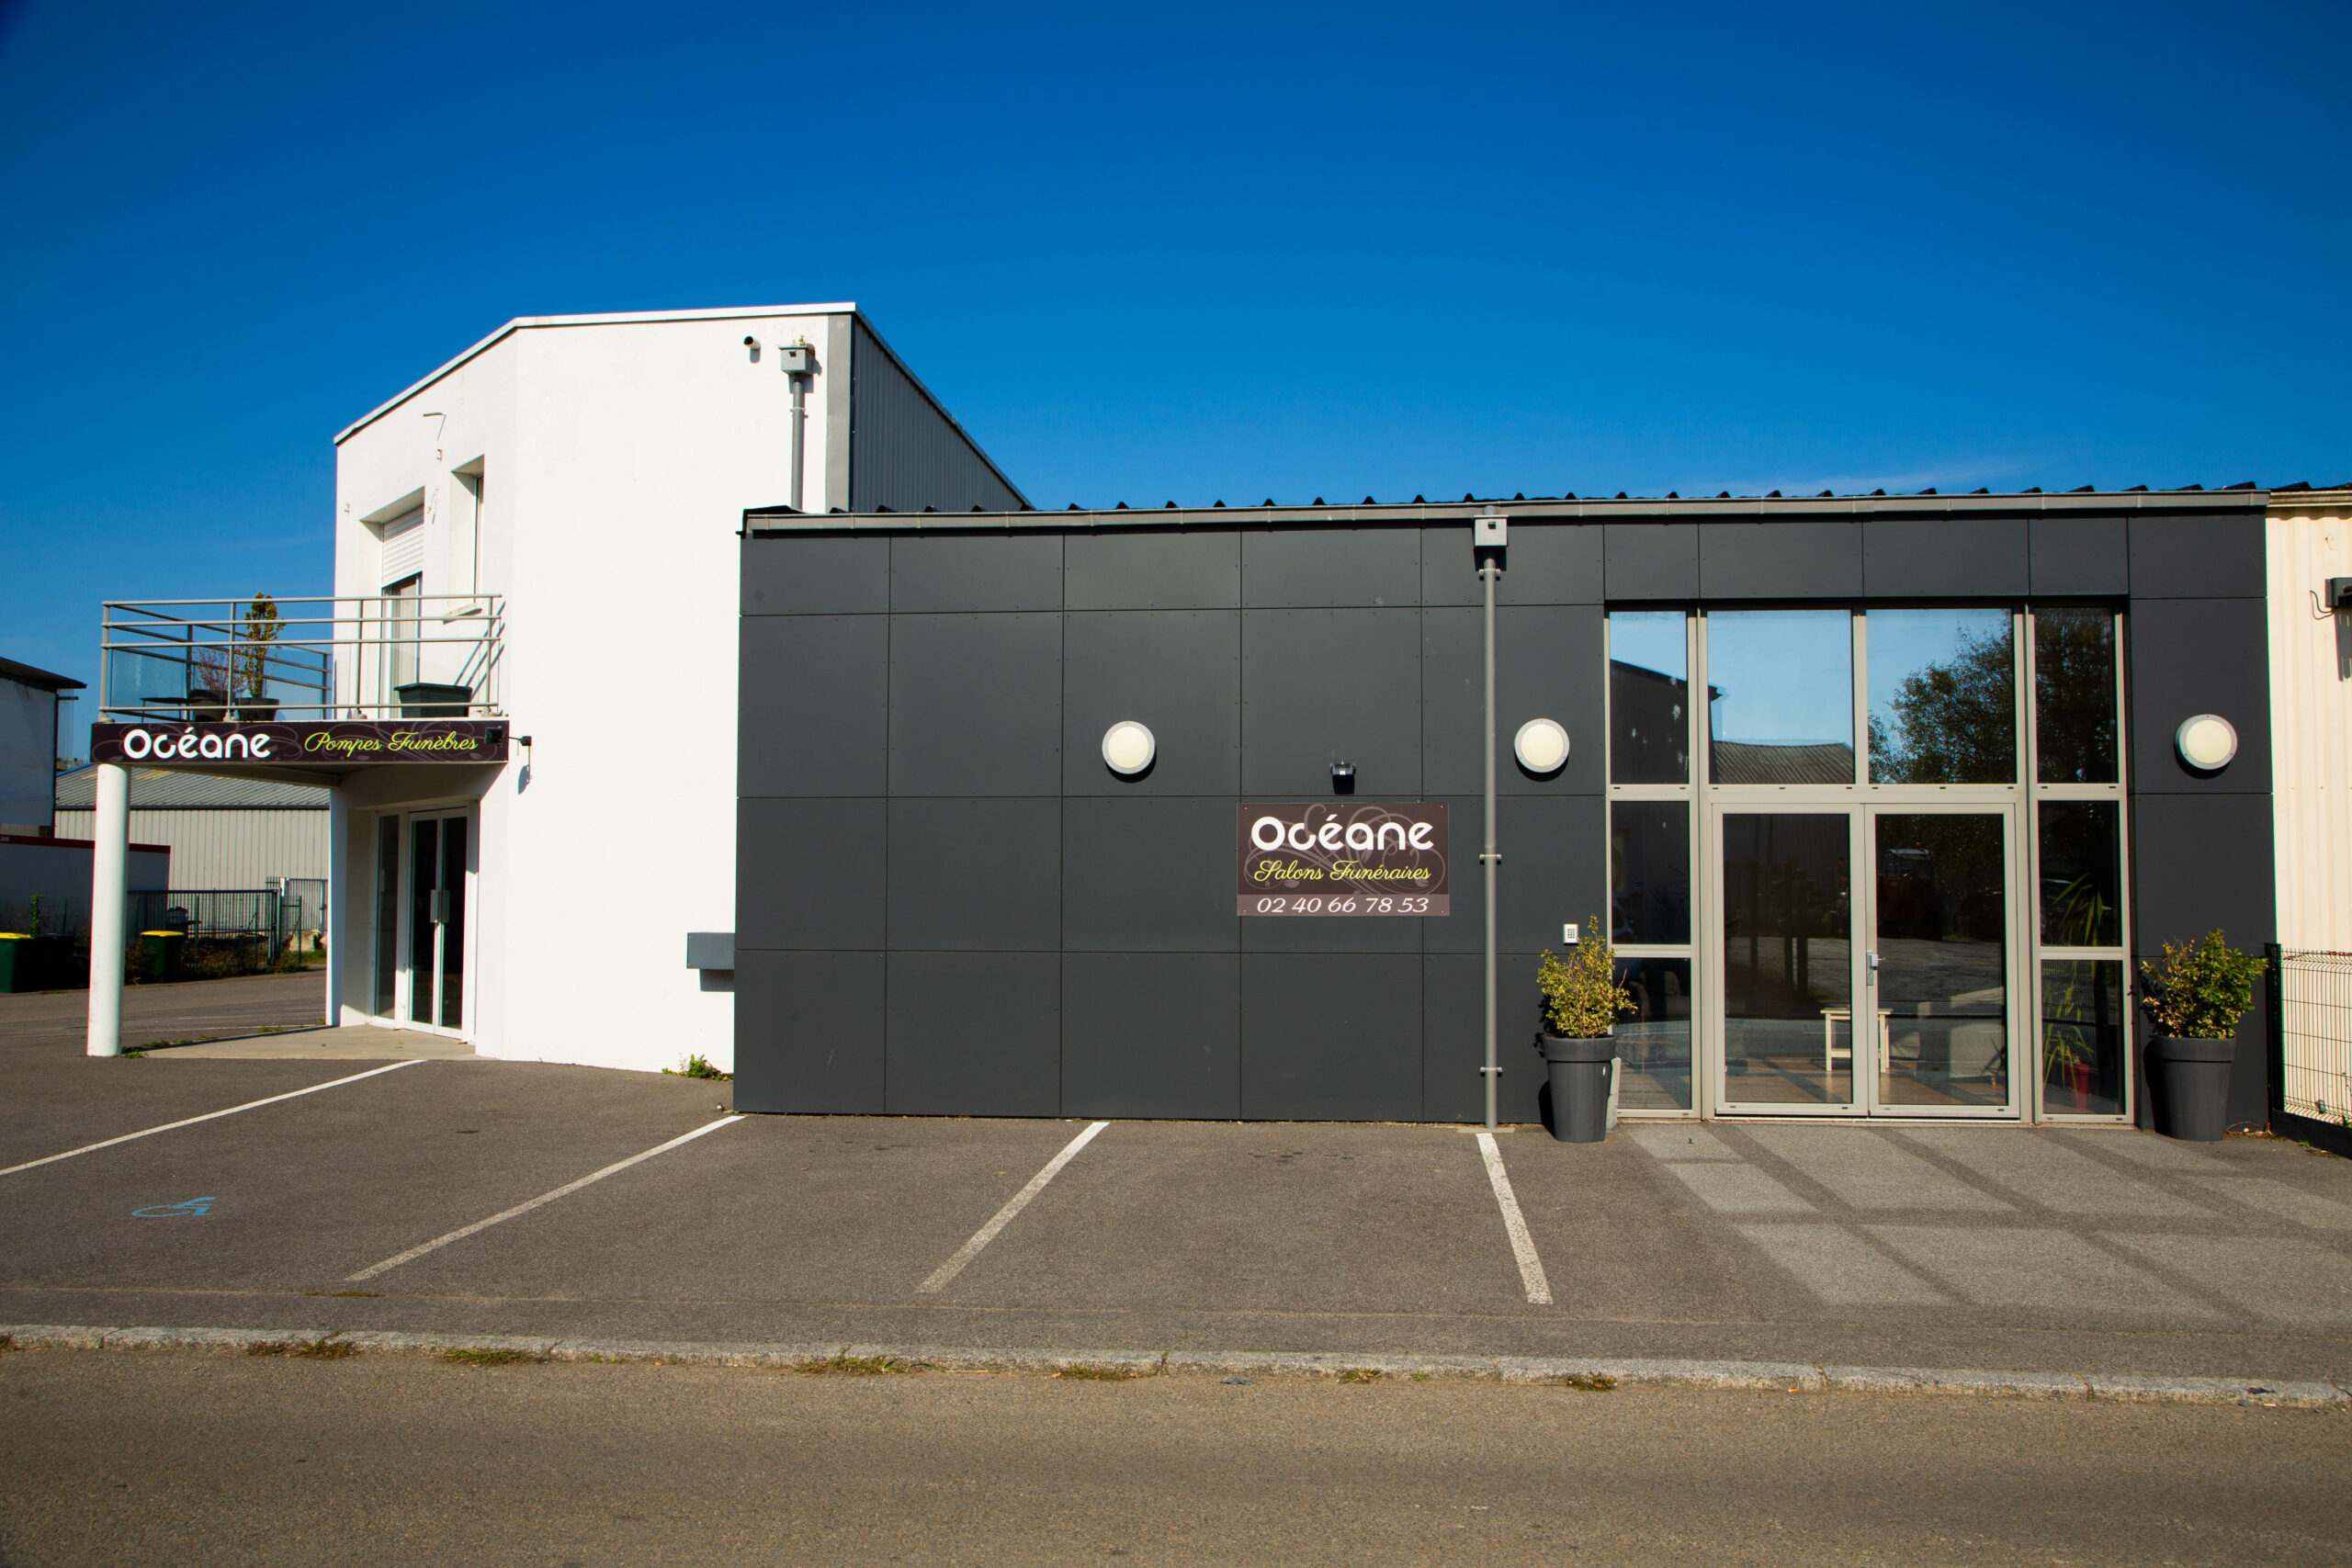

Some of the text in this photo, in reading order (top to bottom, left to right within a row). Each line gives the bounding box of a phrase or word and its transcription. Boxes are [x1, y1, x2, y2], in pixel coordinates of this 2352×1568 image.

[123, 727, 478, 759] Océane Pompes Funèbres
[1250, 814, 1434, 852] Océane
[1254, 860, 1431, 882] Salons Funéraires
[1257, 897, 1430, 913] 02 40 66 78 53
